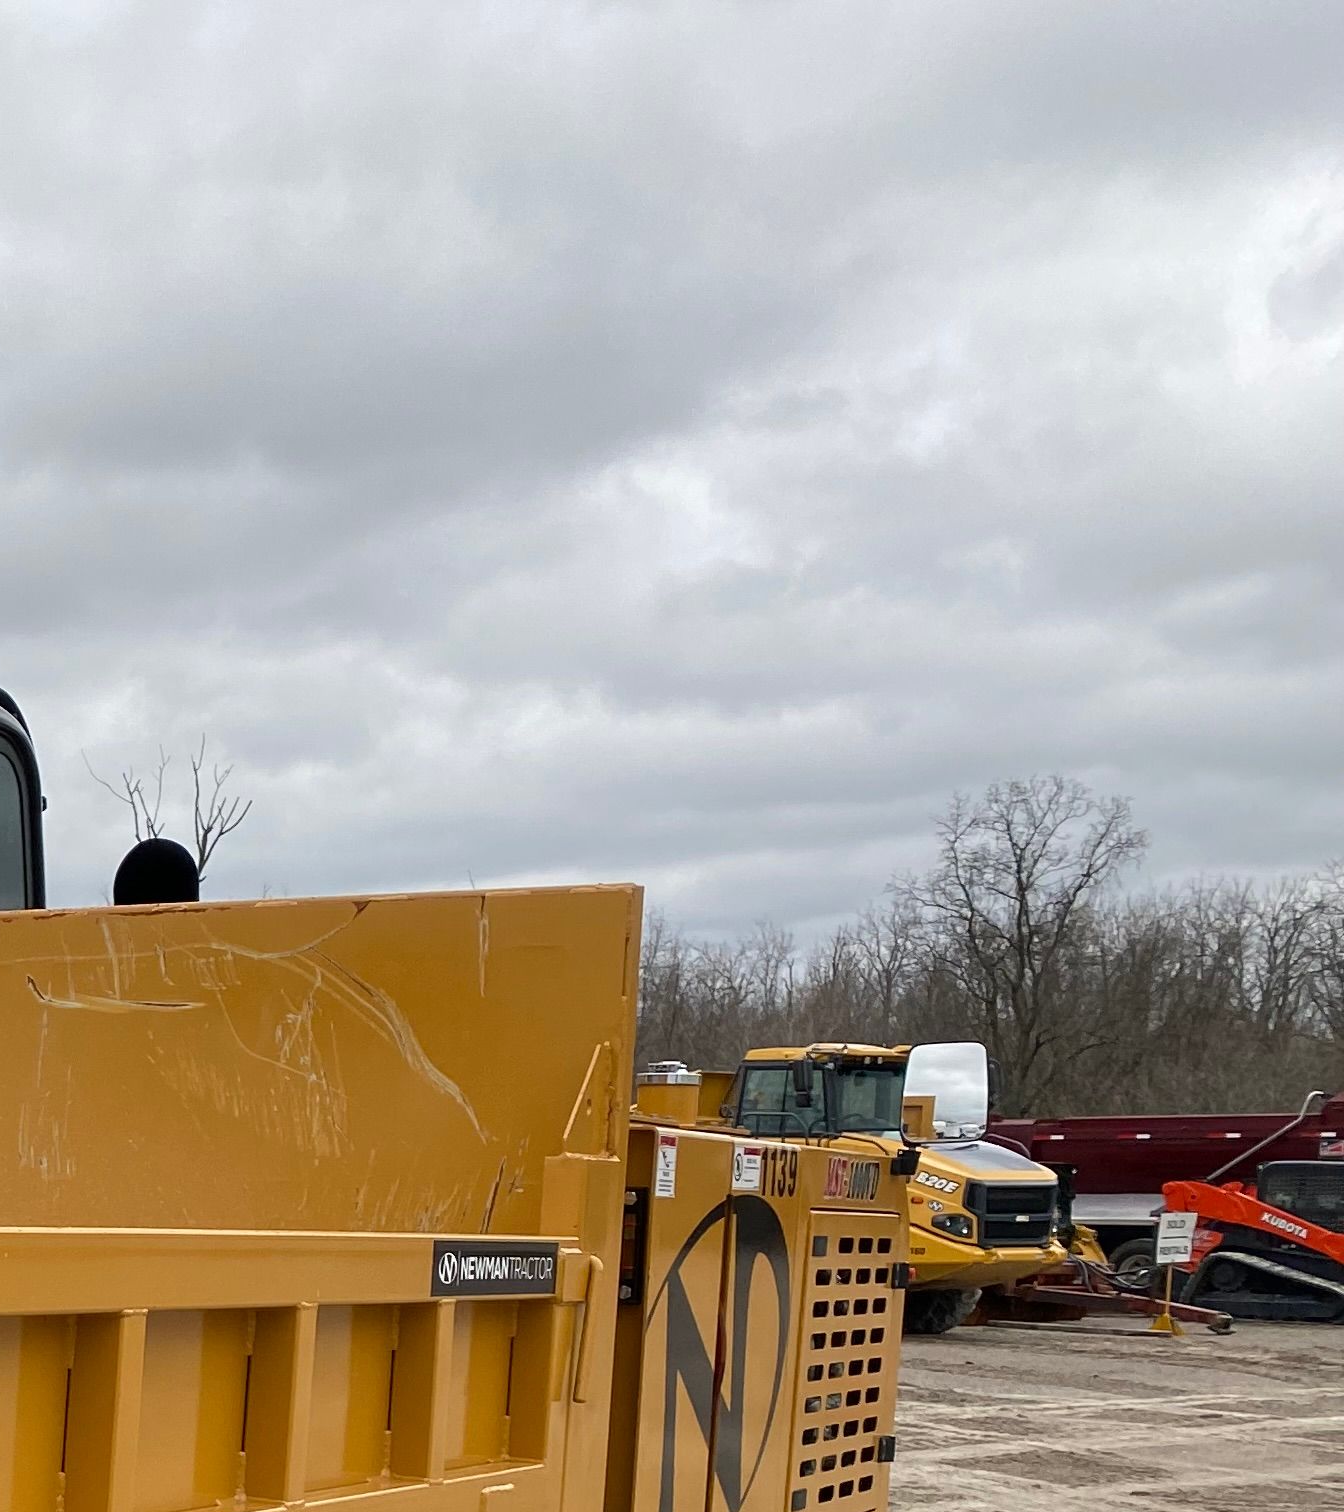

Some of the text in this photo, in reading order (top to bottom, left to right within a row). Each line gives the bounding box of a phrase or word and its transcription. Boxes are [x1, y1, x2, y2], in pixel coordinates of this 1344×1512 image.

[761, 1146, 798, 1197] 1139
[914, 1171, 960, 1194] B20E
[1261, 1212, 1308, 1239] KUBOTA
